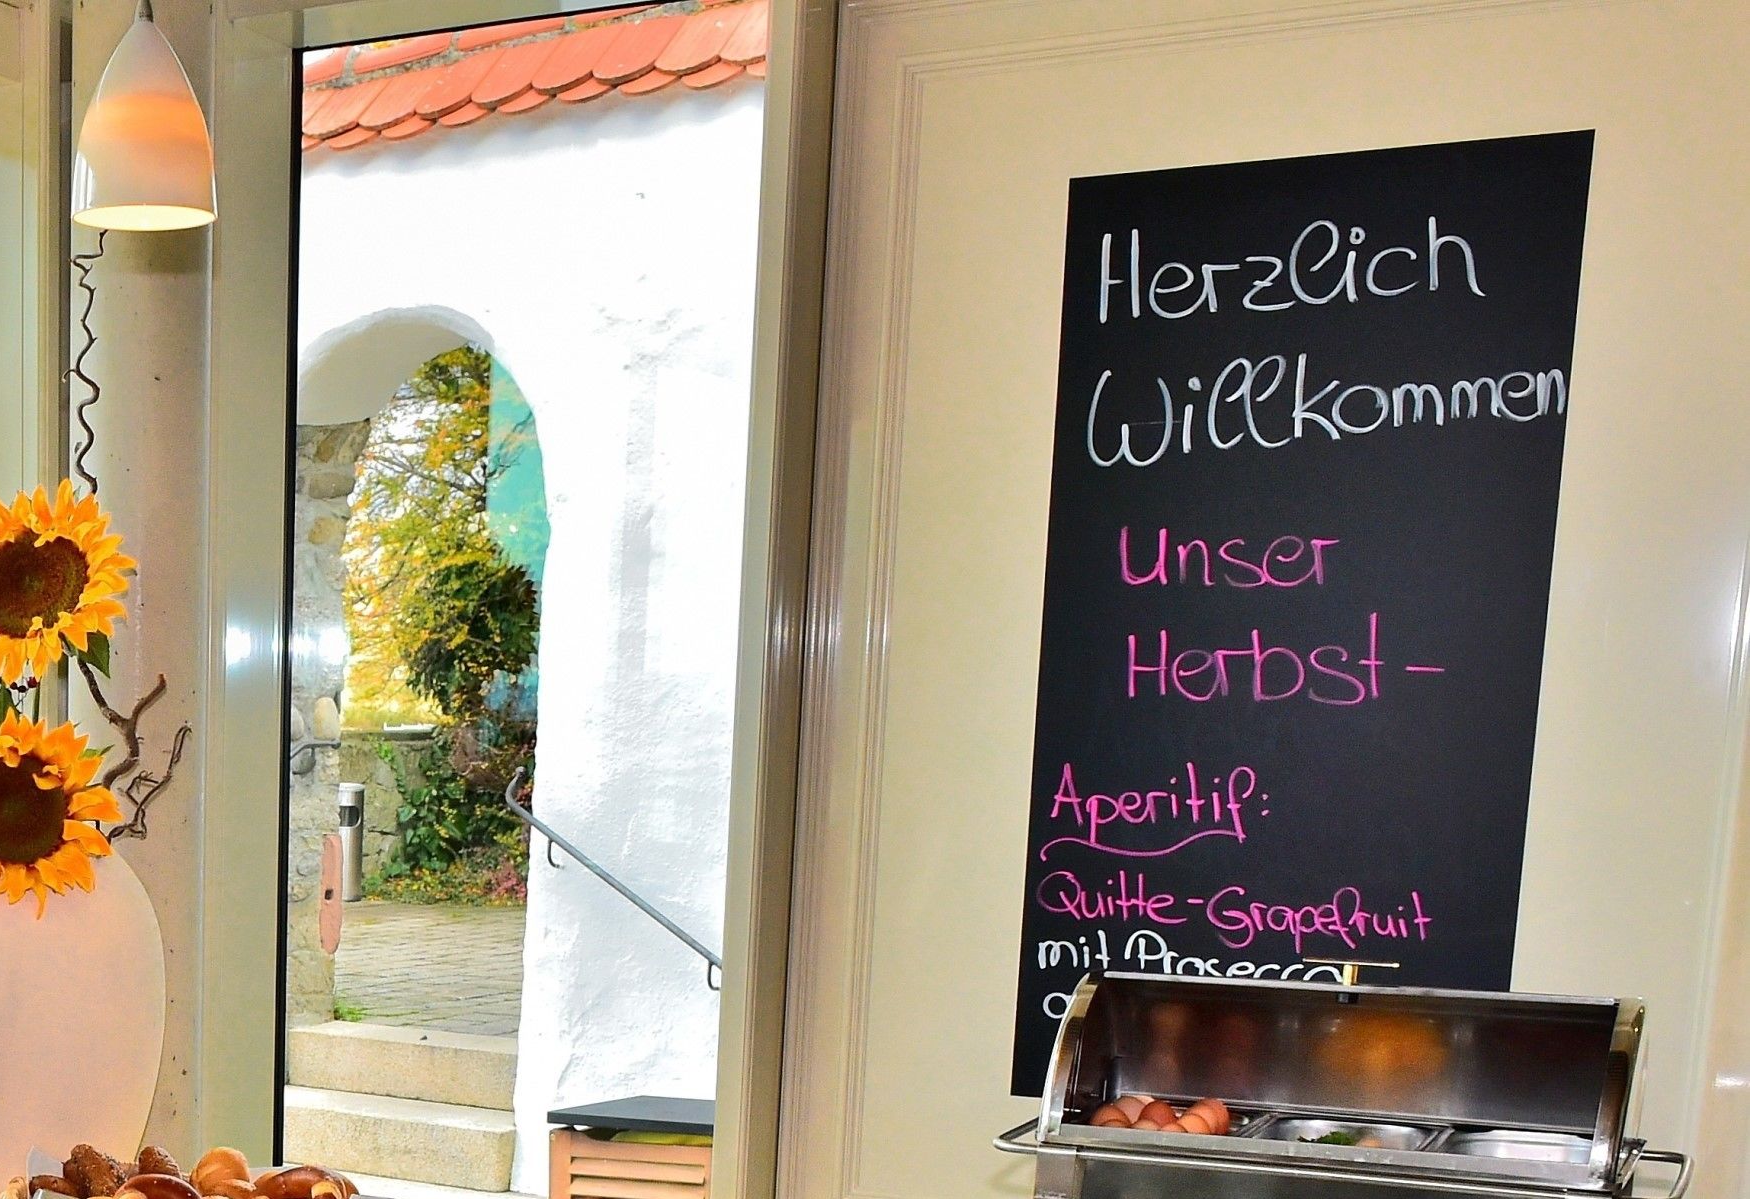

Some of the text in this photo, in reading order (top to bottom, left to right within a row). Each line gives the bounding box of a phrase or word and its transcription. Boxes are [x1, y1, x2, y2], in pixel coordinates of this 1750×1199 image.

[1099, 216, 1486, 324] Herzlich
[1086, 353, 1566, 467] Willkommen
[1119, 526, 1340, 588] Unser
[1050, 762, 1271, 843] Aperitif:
[1036, 869, 1434, 953] Quitte-Grapefruit
[1038, 929, 1111, 969] mit
